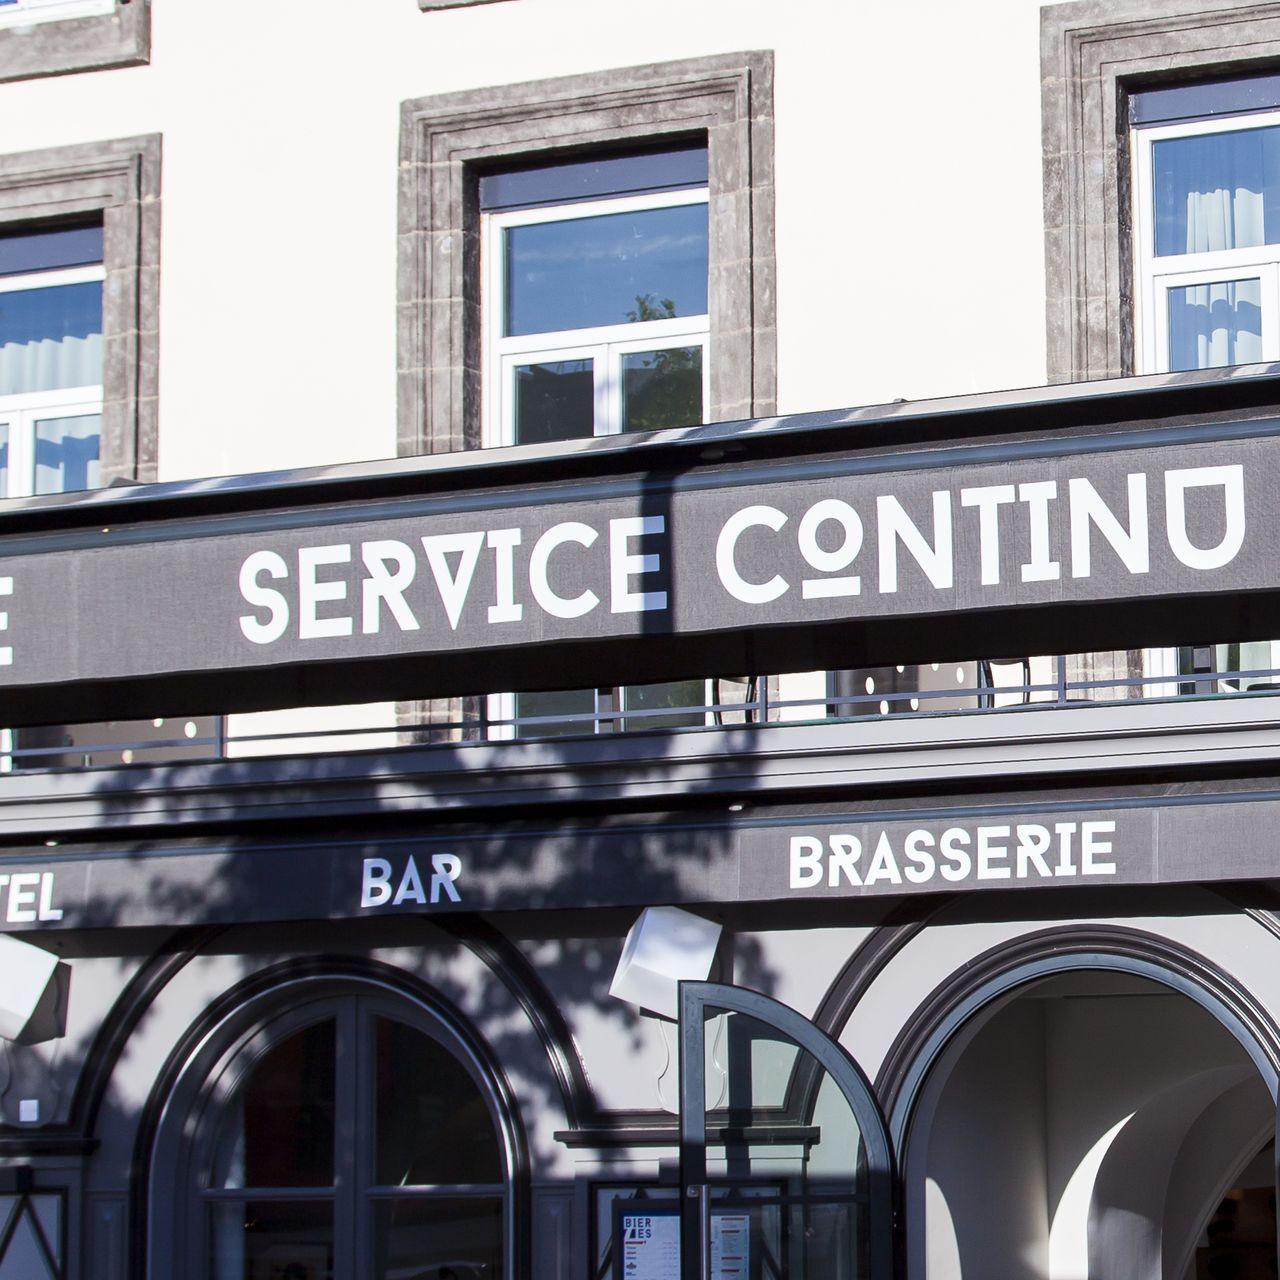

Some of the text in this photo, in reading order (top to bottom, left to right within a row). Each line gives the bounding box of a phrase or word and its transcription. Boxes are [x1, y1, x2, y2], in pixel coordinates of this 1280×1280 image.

[238, 463, 1246, 645] SERVICE CONTINU
[360, 853, 464, 909] BAR
[788, 820, 1117, 890] BRASSERIE
[625, 1217, 652, 1228] BIER
